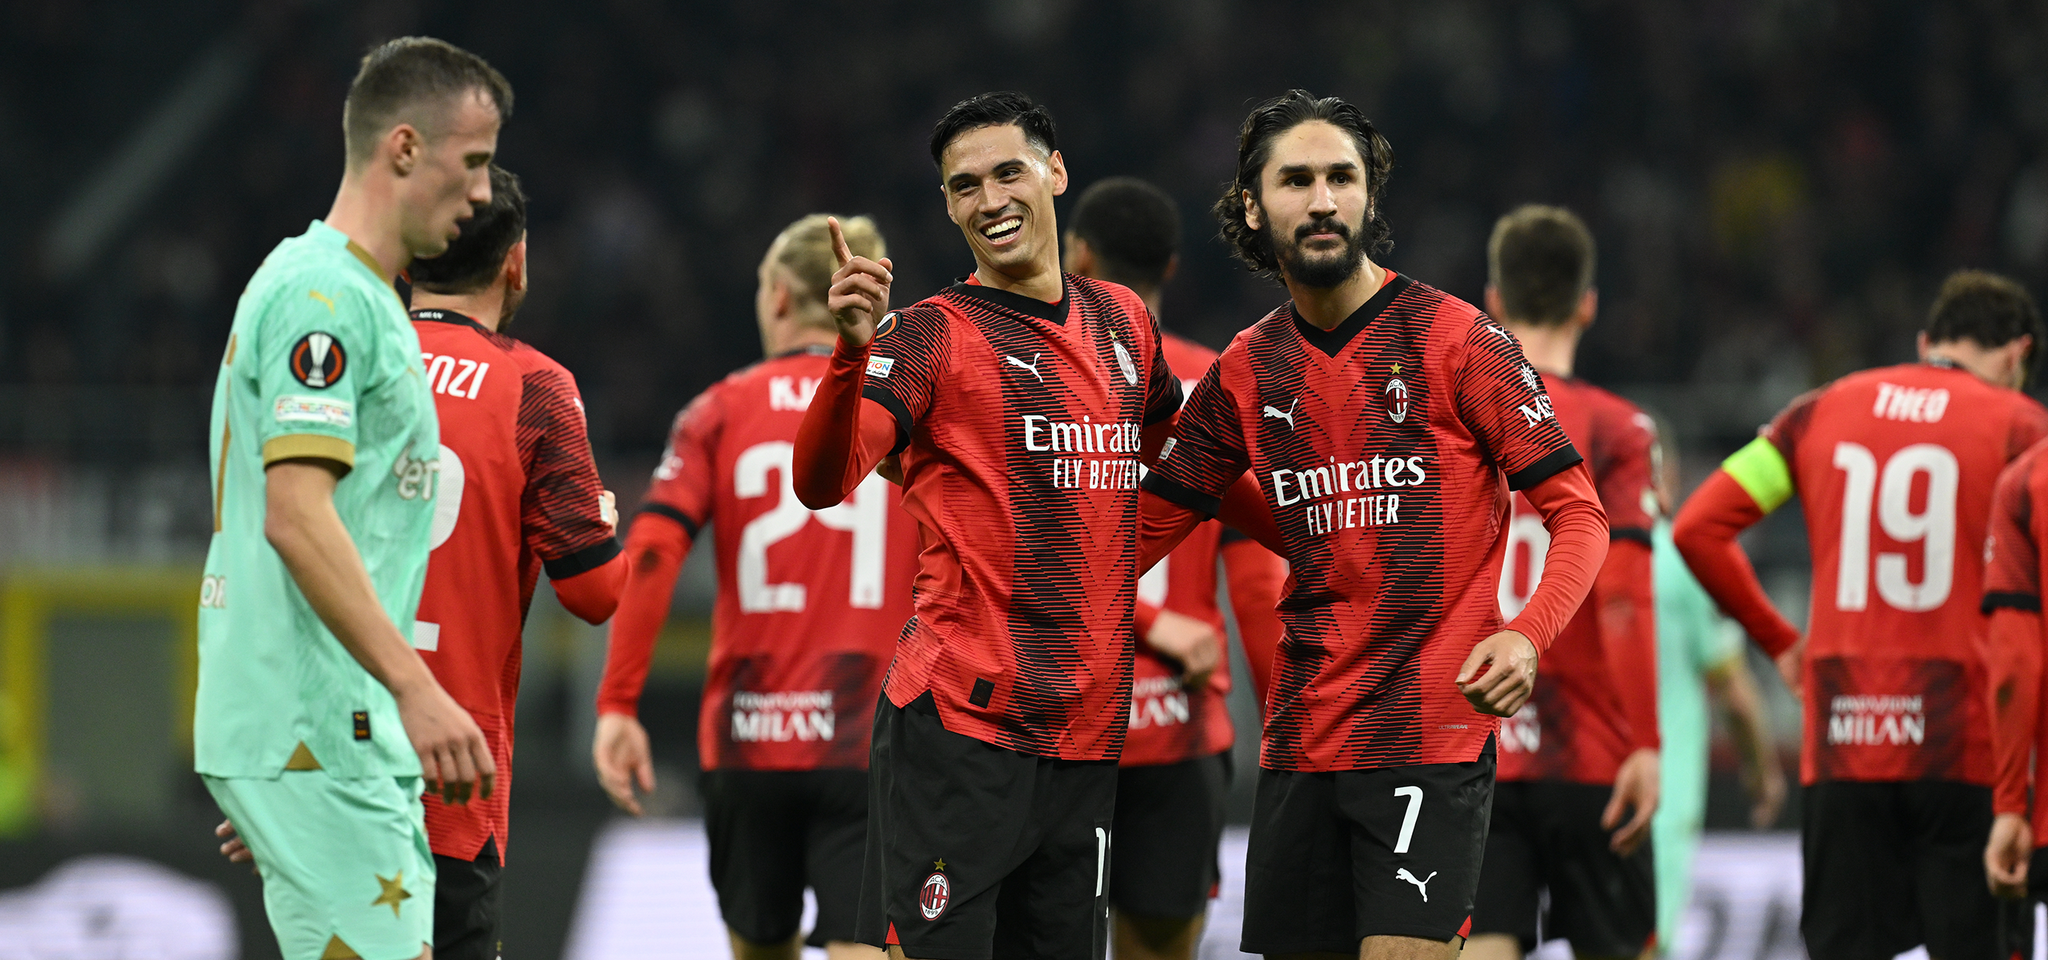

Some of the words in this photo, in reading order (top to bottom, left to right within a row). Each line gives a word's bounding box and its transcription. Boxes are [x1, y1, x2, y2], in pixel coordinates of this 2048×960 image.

[419, 311, 444, 319] MILAN
[769, 375, 823, 412] KJ
[1872, 381, 1950, 423] THEO
[1022, 415, 1141, 453] Emirate
[1053, 458, 1083, 488] FLY
[1089, 459, 1138, 489] BETTER
[1271, 453, 1426, 507] Emirates
[733, 440, 890, 614] 24
[1306, 502, 1333, 536] FLY
[1337, 494, 1400, 530] BETTER
[1832, 440, 1960, 612] 19
[731, 709, 836, 742] MILAN
[1826, 712, 1925, 745] MILAN
[1393, 785, 1424, 854] 7
[928, 876, 946, 885] ACM
[1095, 826, 1111, 897] 1
